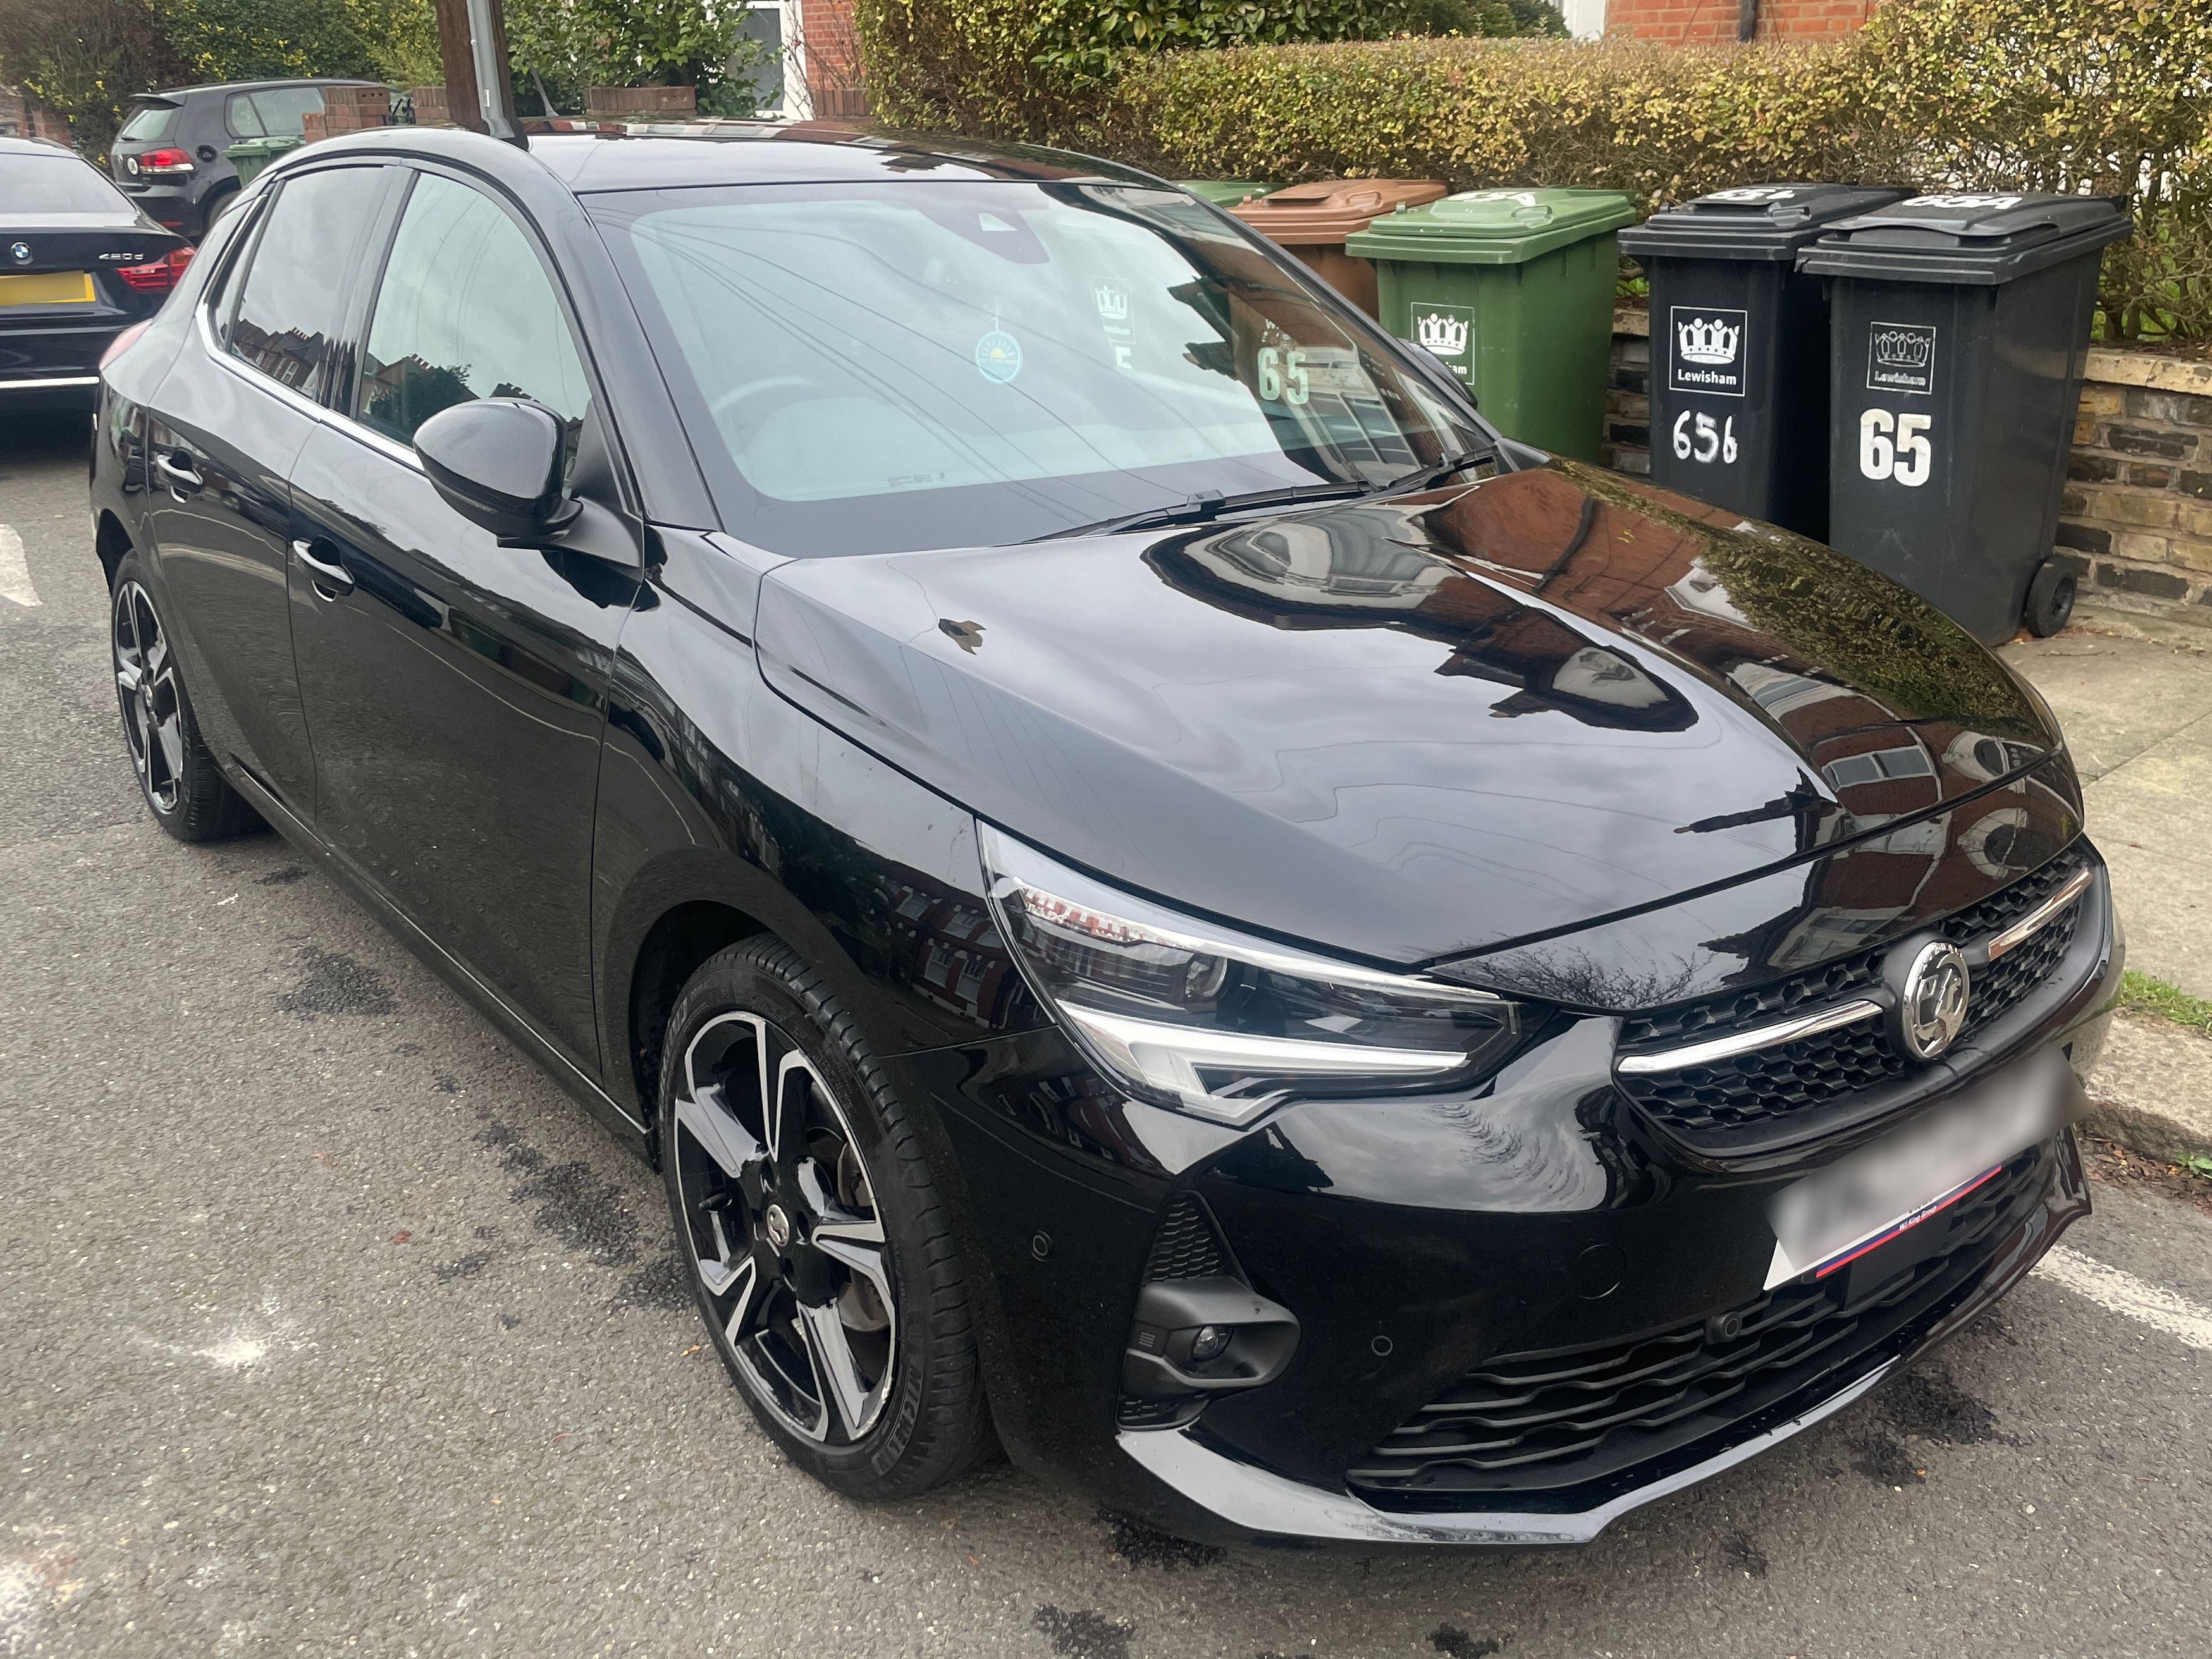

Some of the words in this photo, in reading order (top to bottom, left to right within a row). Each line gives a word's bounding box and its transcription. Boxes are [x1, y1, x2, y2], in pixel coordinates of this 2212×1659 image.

[1258, 347, 1309, 405] 65
[1678, 369, 1736, 385] Lewisham
[1860, 408, 1931, 487] 65
